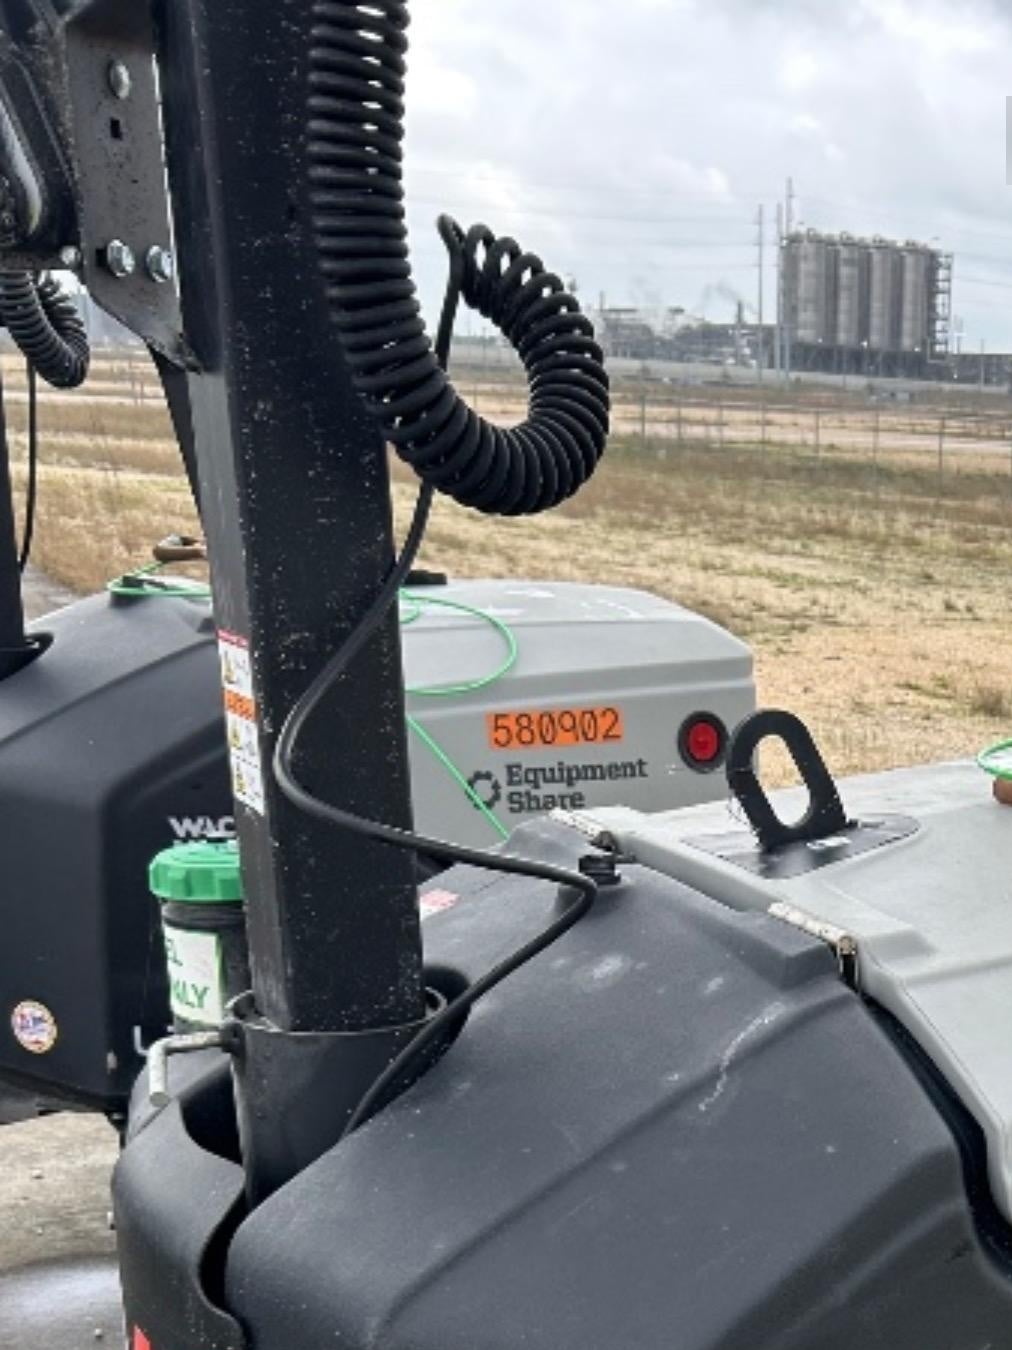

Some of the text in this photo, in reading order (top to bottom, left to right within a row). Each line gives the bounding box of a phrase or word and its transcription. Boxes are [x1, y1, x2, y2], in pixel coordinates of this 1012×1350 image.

[493, 707, 622, 748] 580902
[505, 757, 649, 790] Equipment
[506, 789, 586, 814] Share
